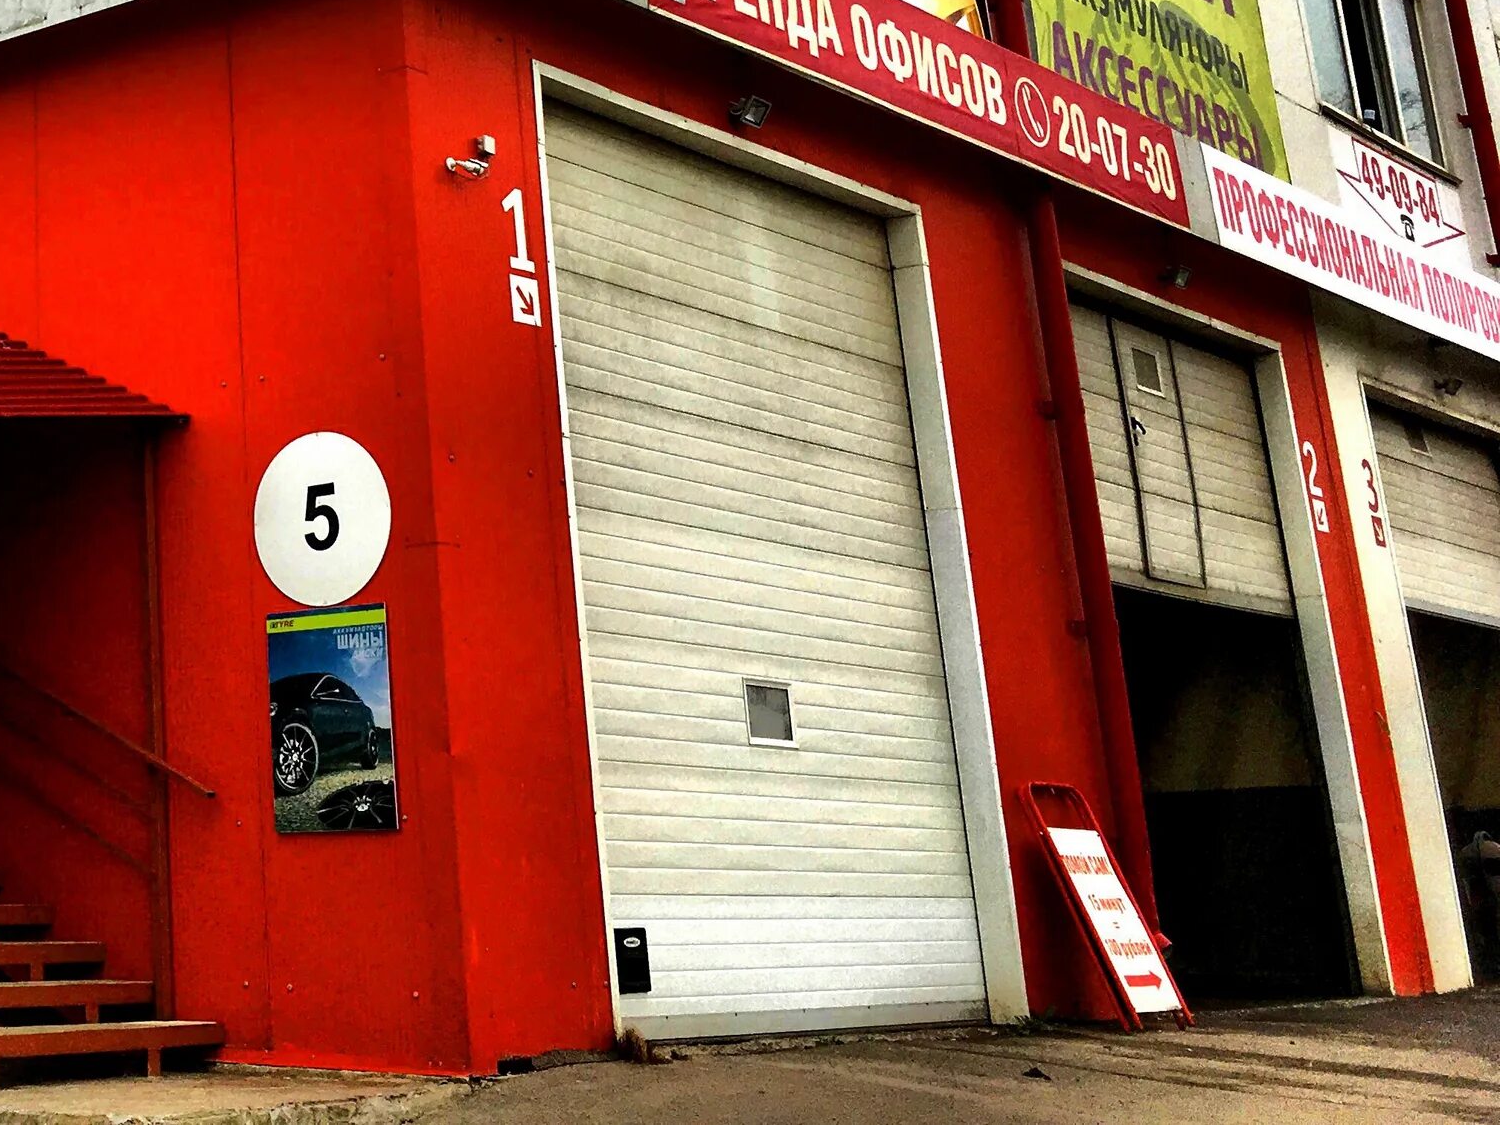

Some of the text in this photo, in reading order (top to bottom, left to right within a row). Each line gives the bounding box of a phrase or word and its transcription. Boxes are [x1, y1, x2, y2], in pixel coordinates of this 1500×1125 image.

[850, 3, 1007, 128] ОФИСОВ
[1052, 95, 1176, 202] 20-07-30
[1052, 20, 1265, 174] АКСЕССУАРЫ
[1360, 151, 1441, 228] 49-09-84
[501, 187, 536, 274] 1
[1212, 165, 1425, 313] ПРОФЕССИОНАЛЬНАЯ
[1302, 440, 1324, 498] 2
[1361, 458, 1380, 513] 3
[304, 481, 340, 552] 5
[336, 631, 384, 650] ШИНЫ
